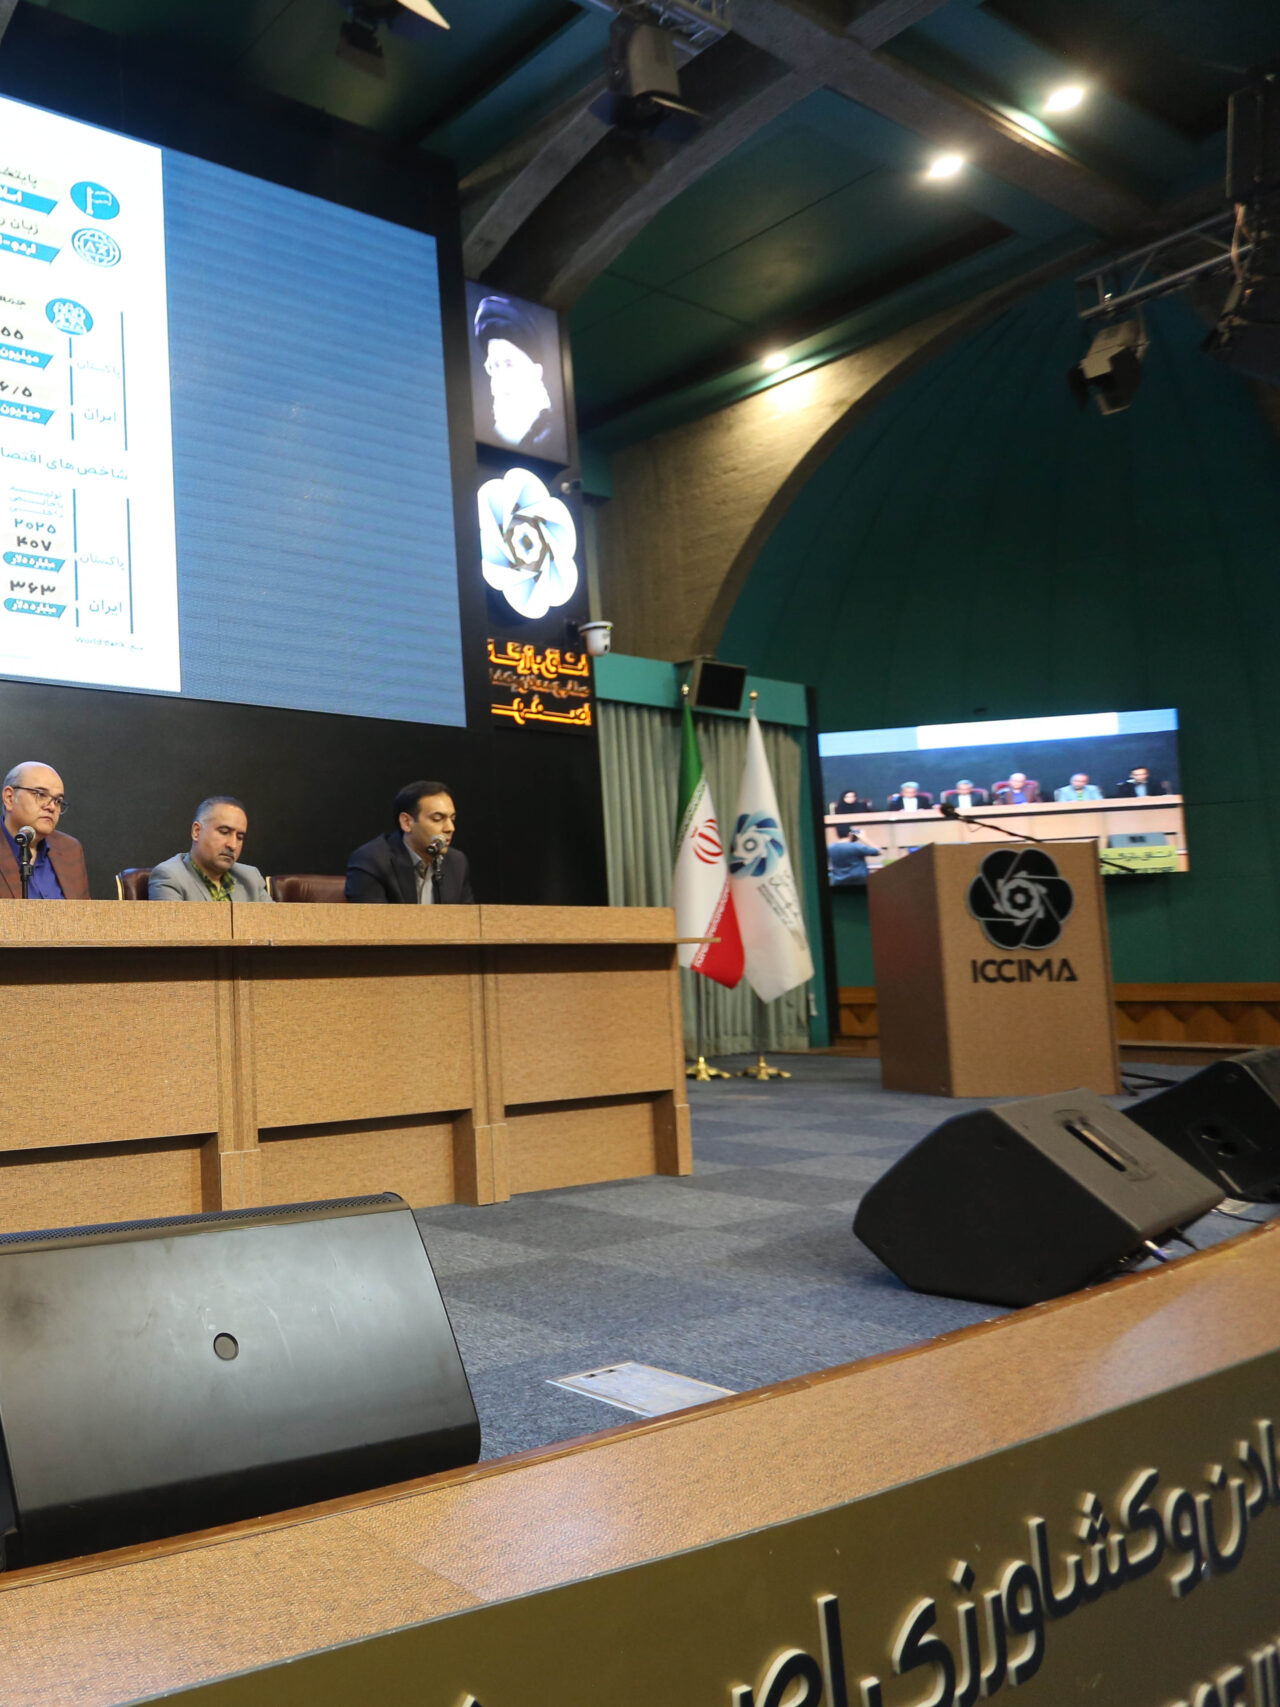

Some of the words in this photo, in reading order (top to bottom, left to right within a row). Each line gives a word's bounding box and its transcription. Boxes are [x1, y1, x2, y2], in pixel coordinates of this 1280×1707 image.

[10, 217, 39, 235] زبان
[0, 347, 40, 364] میلیون
[0, 403, 41, 420] میلیون
[84, 408, 117, 424] ایران
[14, 518, 57, 534] ۲۰۲۵
[16, 535, 52, 552] ۴۰۷
[79, 553, 125, 571] پاکستان
[10, 579, 56, 596] ۳۶۳
[89, 600, 123, 616] ایران
[971, 958, 1078, 983] ICCIMA
